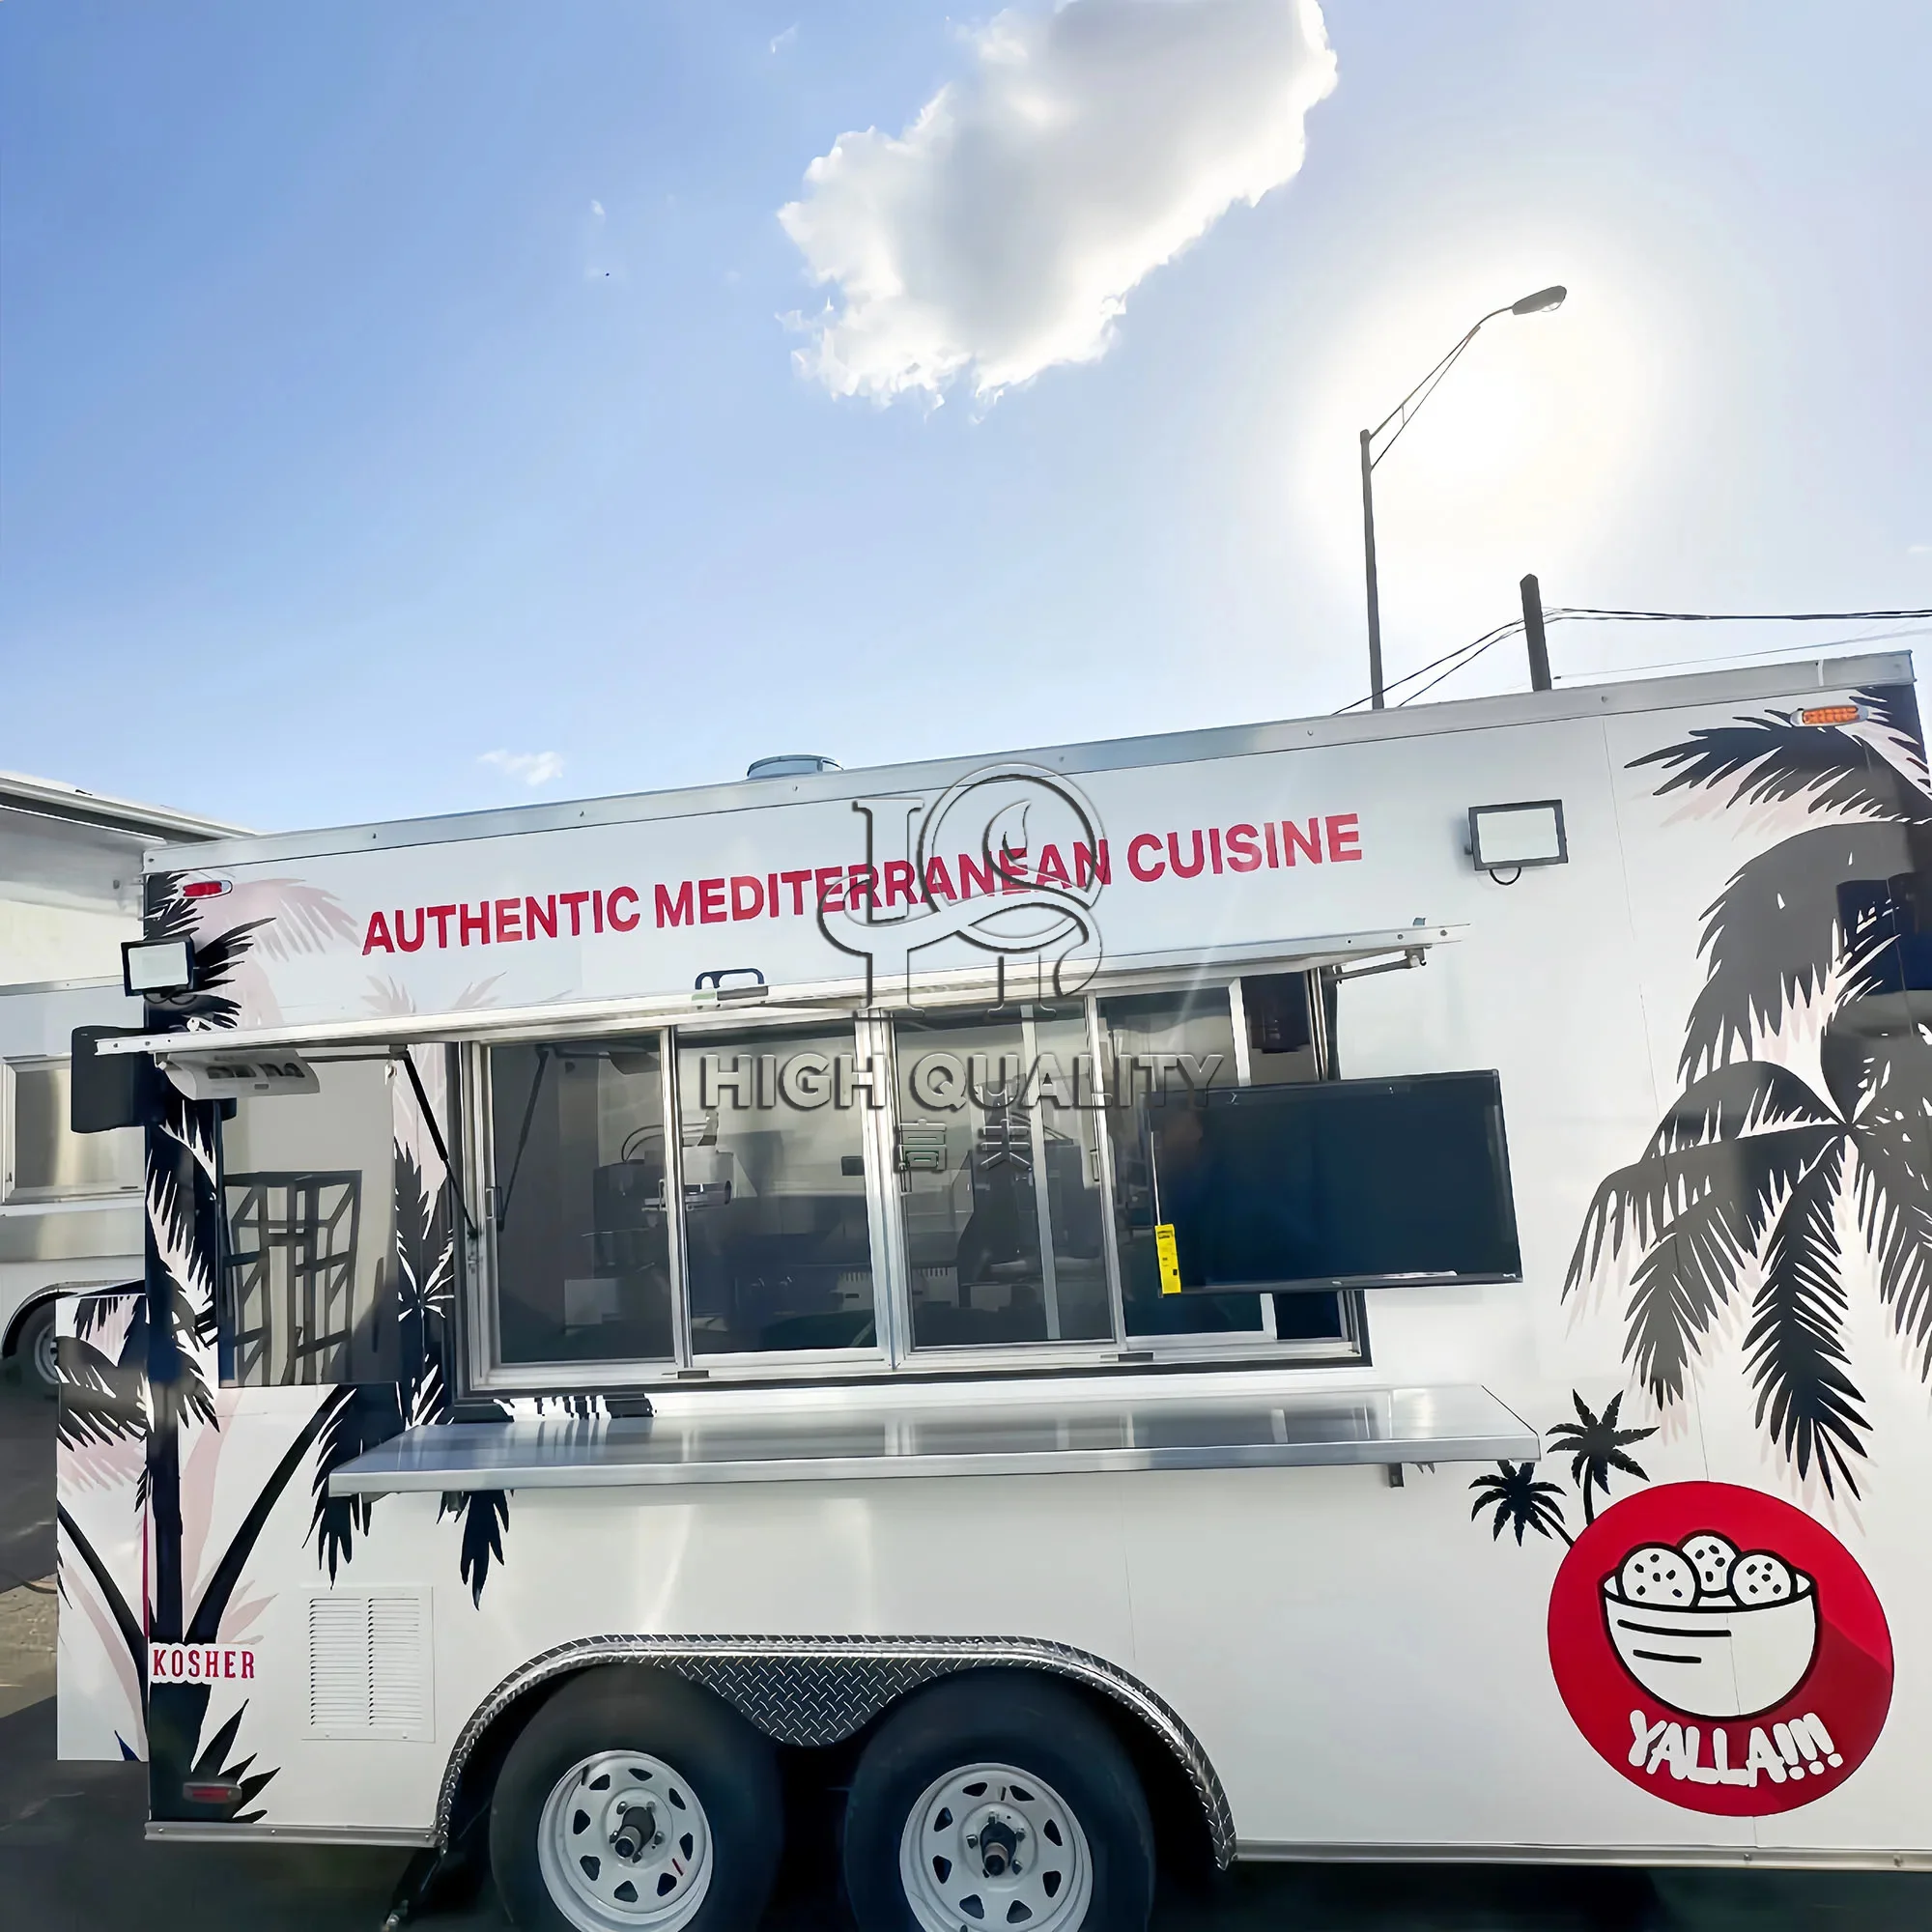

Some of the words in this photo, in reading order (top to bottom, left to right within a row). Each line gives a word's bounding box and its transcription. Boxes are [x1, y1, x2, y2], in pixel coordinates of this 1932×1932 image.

[362, 886, 640, 955] AUTHENTIC
[656, 838, 1111, 928] MEDITERRANEAN
[1126, 812, 1362, 883] CUISINE
[152, 1649, 256, 1679] KOSHER
[1628, 1710, 1844, 1787] YALLA!!!
